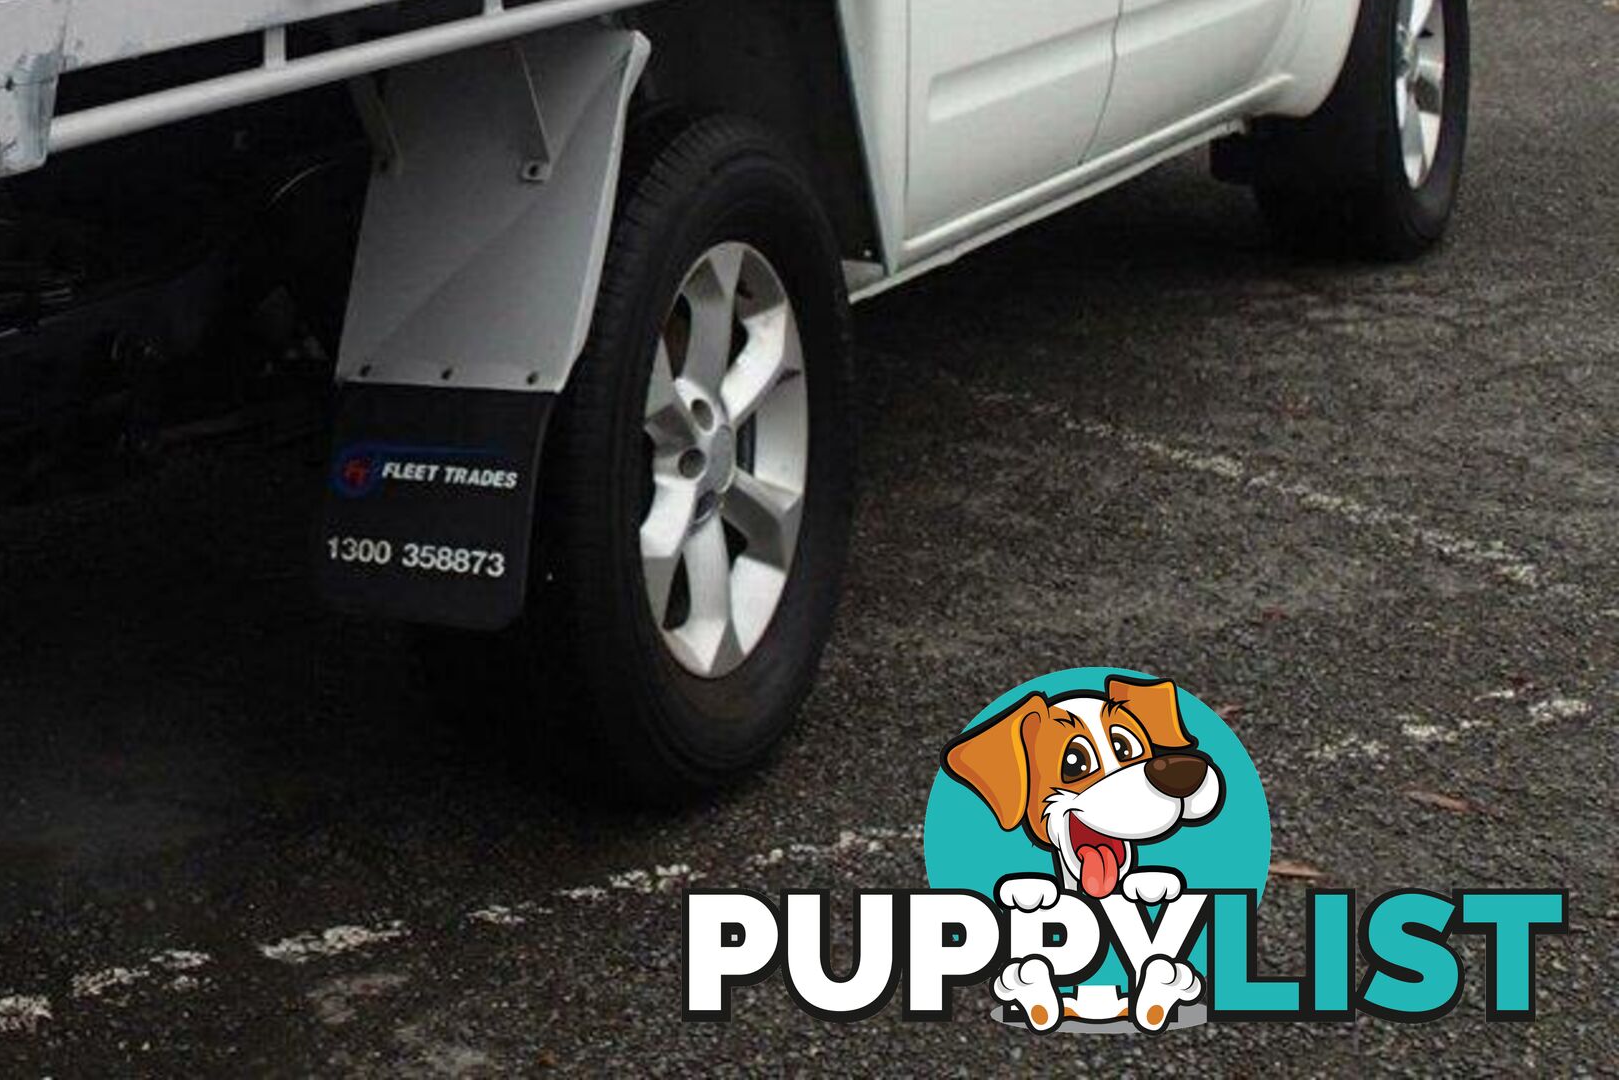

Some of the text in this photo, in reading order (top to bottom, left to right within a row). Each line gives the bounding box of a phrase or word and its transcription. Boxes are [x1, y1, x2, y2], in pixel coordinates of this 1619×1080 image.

[382, 461, 519, 490] FLEET TRADES
[327, 536, 506, 578] 1300 358873
